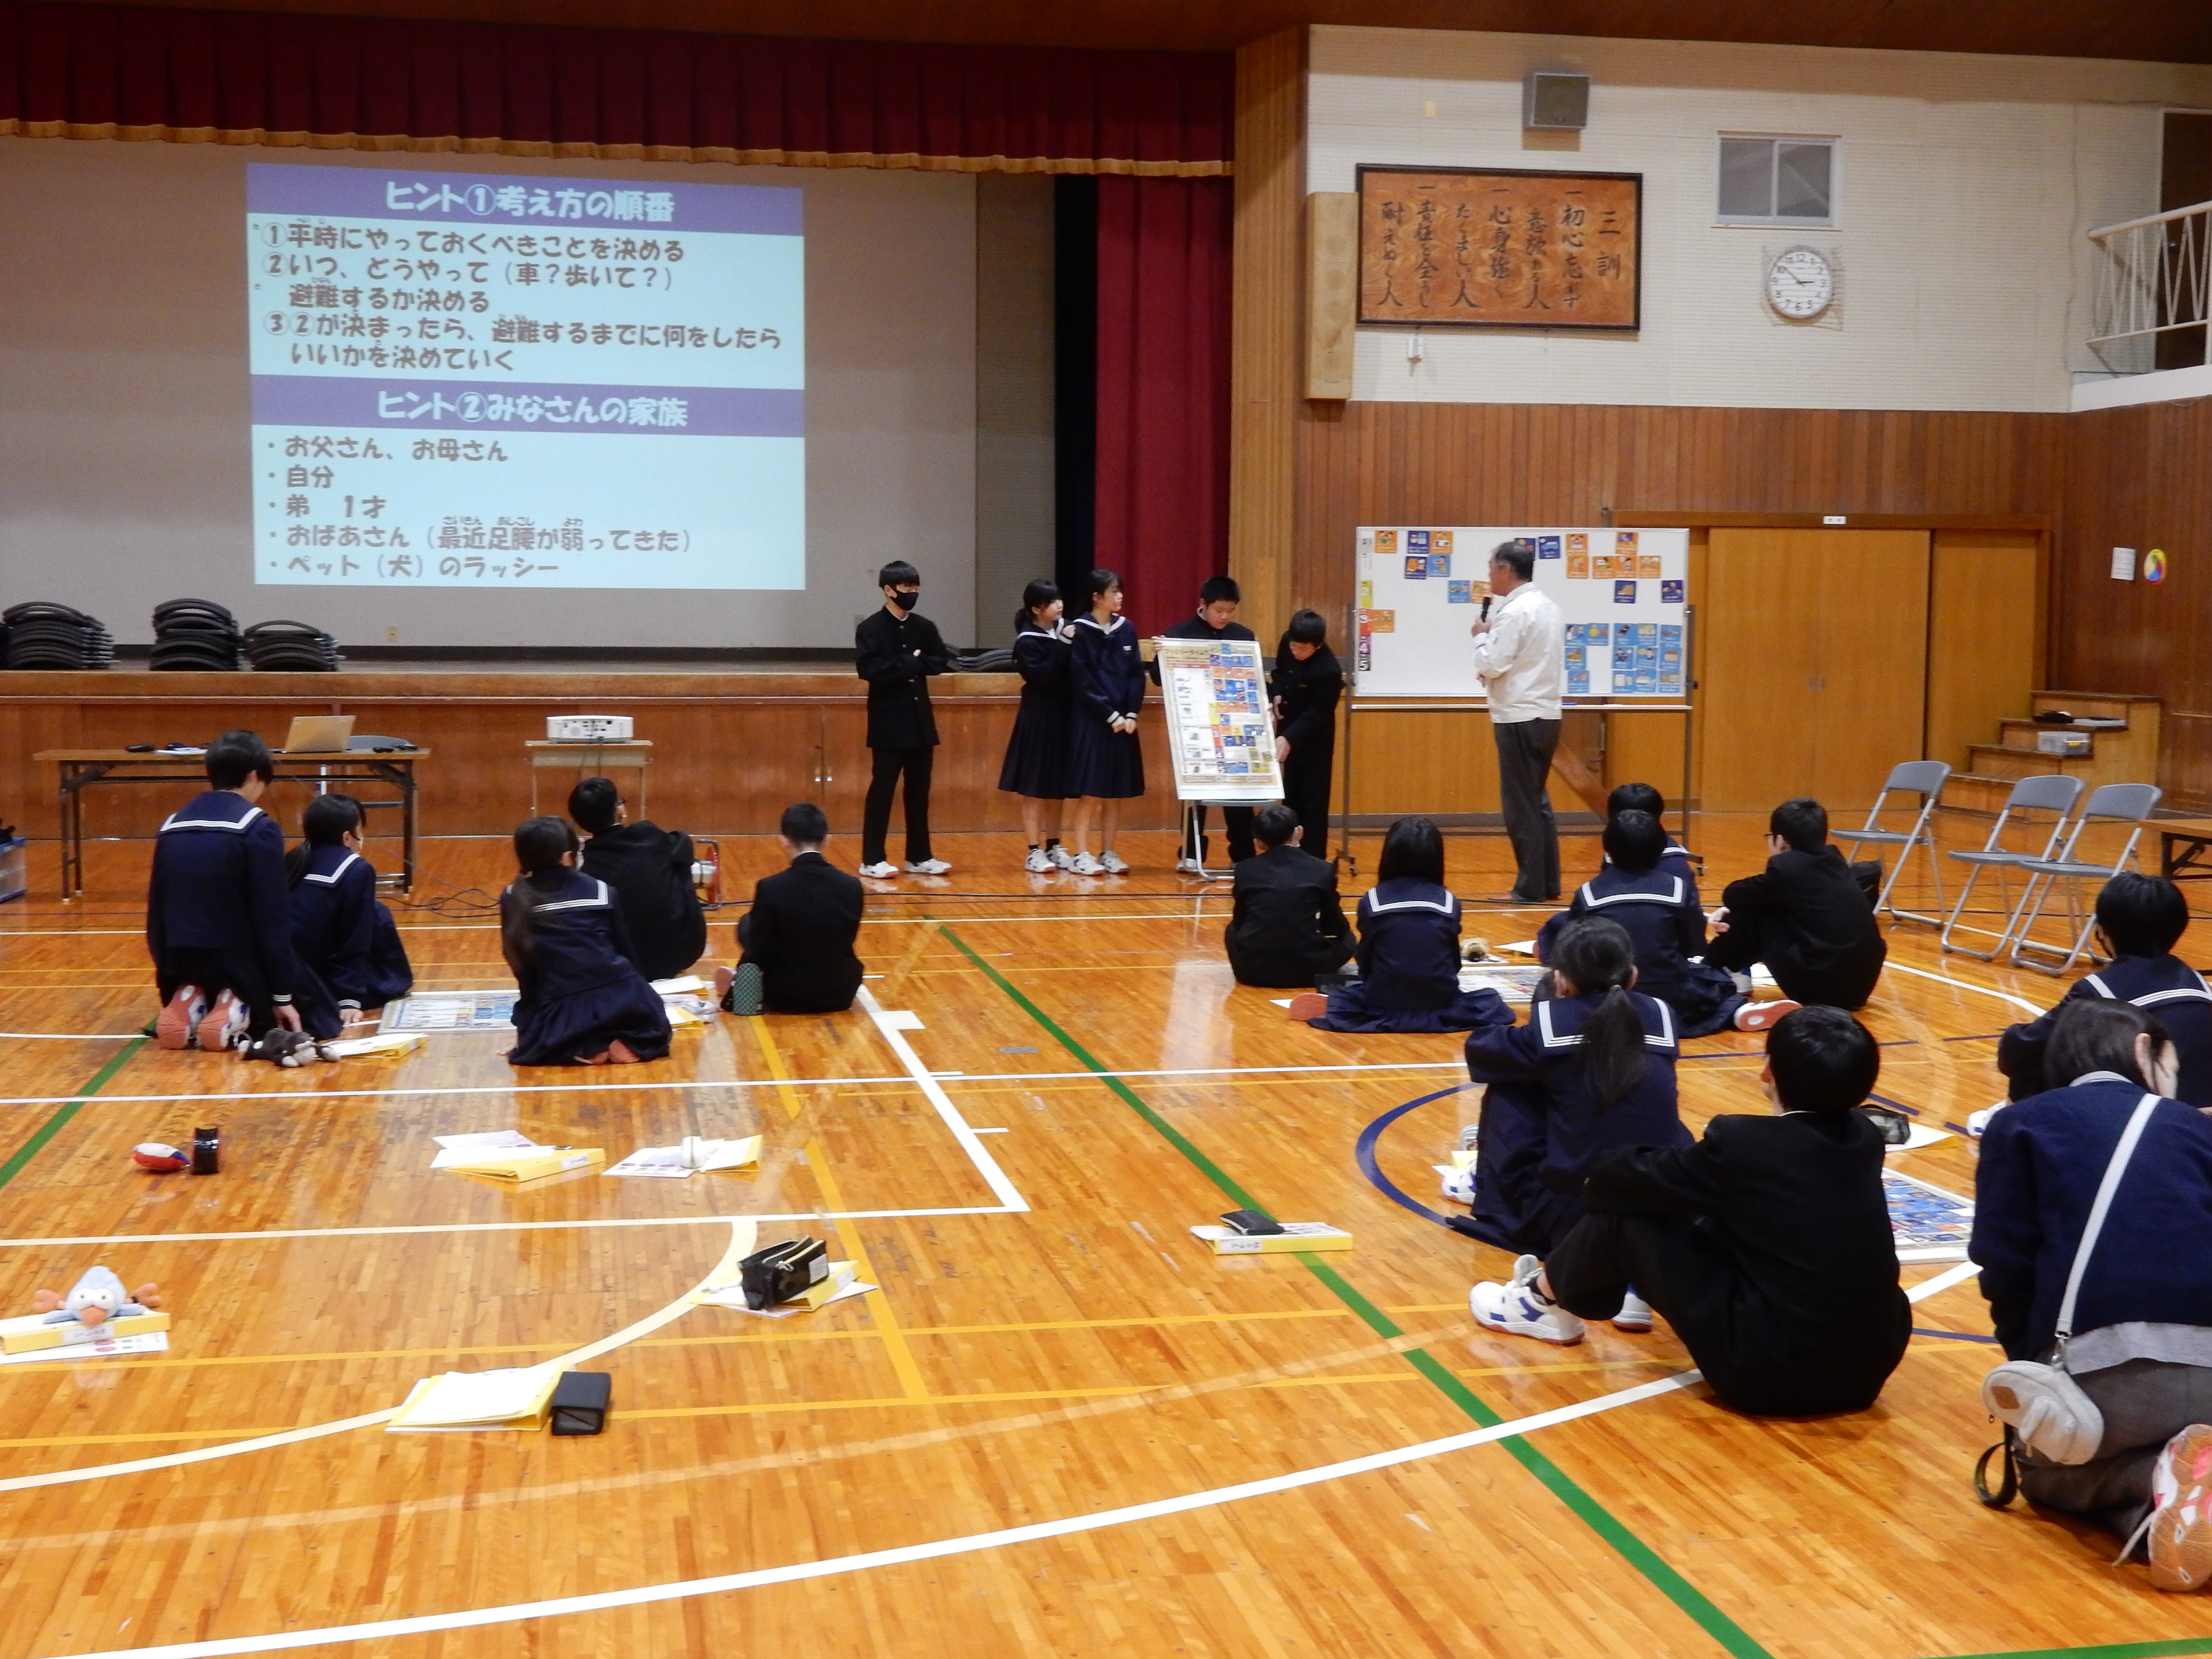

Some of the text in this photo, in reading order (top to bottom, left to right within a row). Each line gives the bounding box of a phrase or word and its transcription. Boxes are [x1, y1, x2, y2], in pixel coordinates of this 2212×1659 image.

[386, 181, 674, 222] ヒント①考え方の順番
[262, 222, 684, 262] ①平時にやっておくべきことを決める
[1595, 210, 1622, 280] 三訓
[289, 283, 489, 313] 避難するか決める
[264, 311, 780, 349] ③②が決まったら、避難するまでに何をしたら
[291, 343, 514, 371] いいかを決めていく
[378, 391, 688, 426] ヒント②みなさんの家族
[288, 464, 334, 489] 自分
[287, 494, 386, 518] 弟 1才
